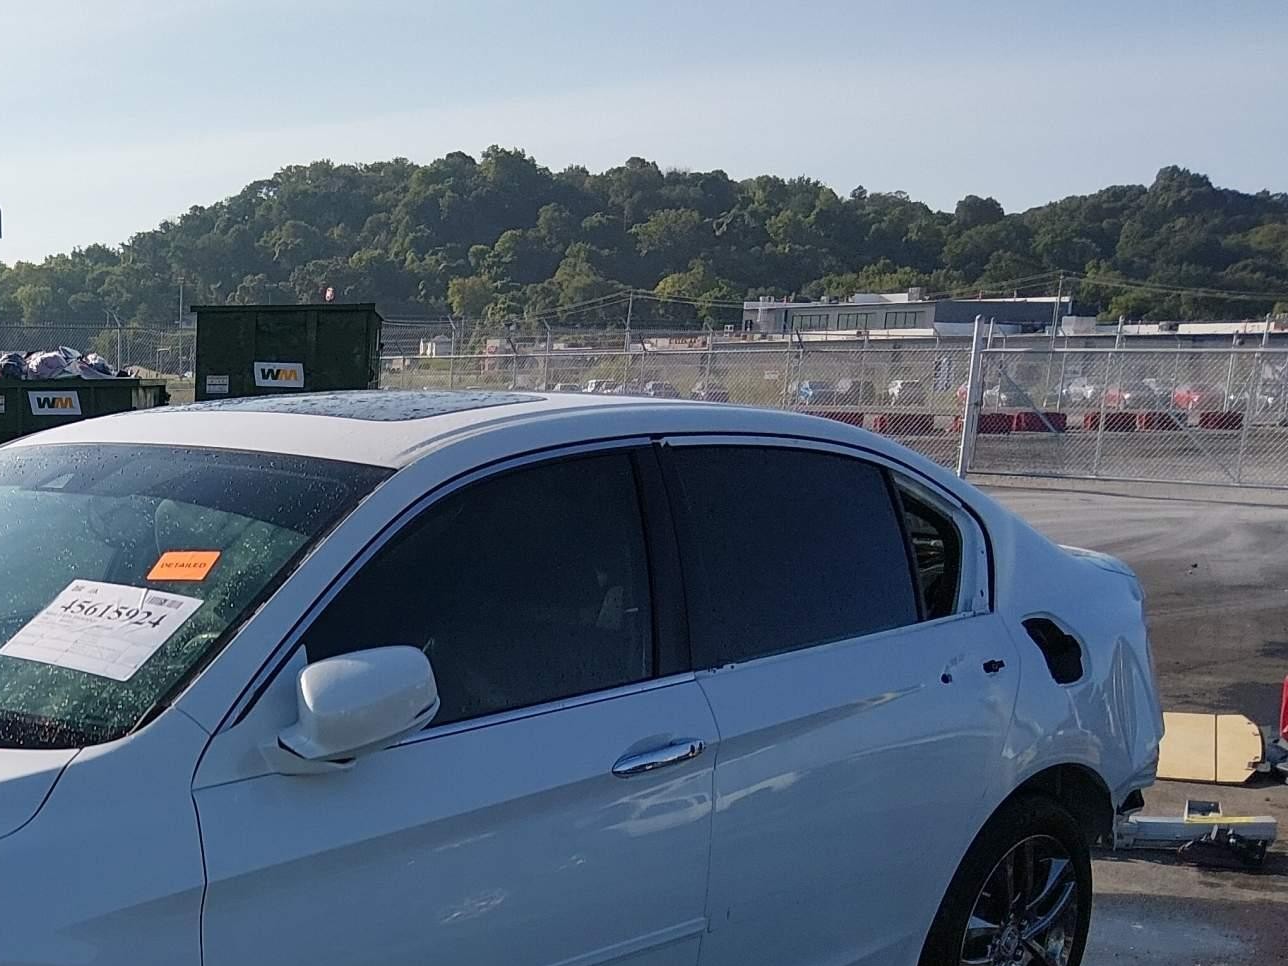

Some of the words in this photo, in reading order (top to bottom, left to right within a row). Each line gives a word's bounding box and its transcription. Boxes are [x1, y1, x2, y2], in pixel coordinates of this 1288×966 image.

[260, 368, 298, 380] WM
[36, 396, 73, 409] WM
[61, 599, 167, 628] 45615924
